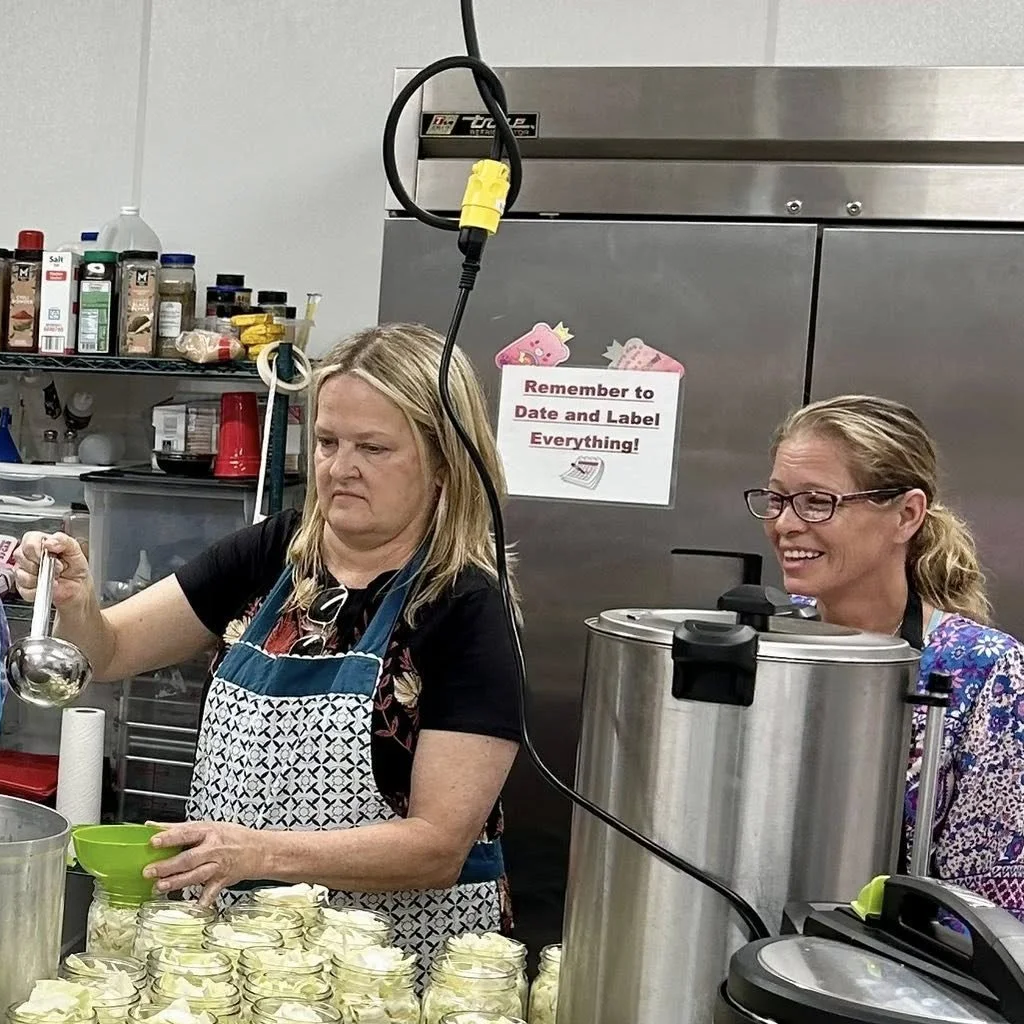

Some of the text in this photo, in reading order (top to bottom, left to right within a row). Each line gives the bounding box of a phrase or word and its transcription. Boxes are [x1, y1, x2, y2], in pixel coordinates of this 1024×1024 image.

[524, 380, 655, 400] Remember to
[514, 405, 660, 426] Date and Label
[530, 432, 640, 454] Everything!
